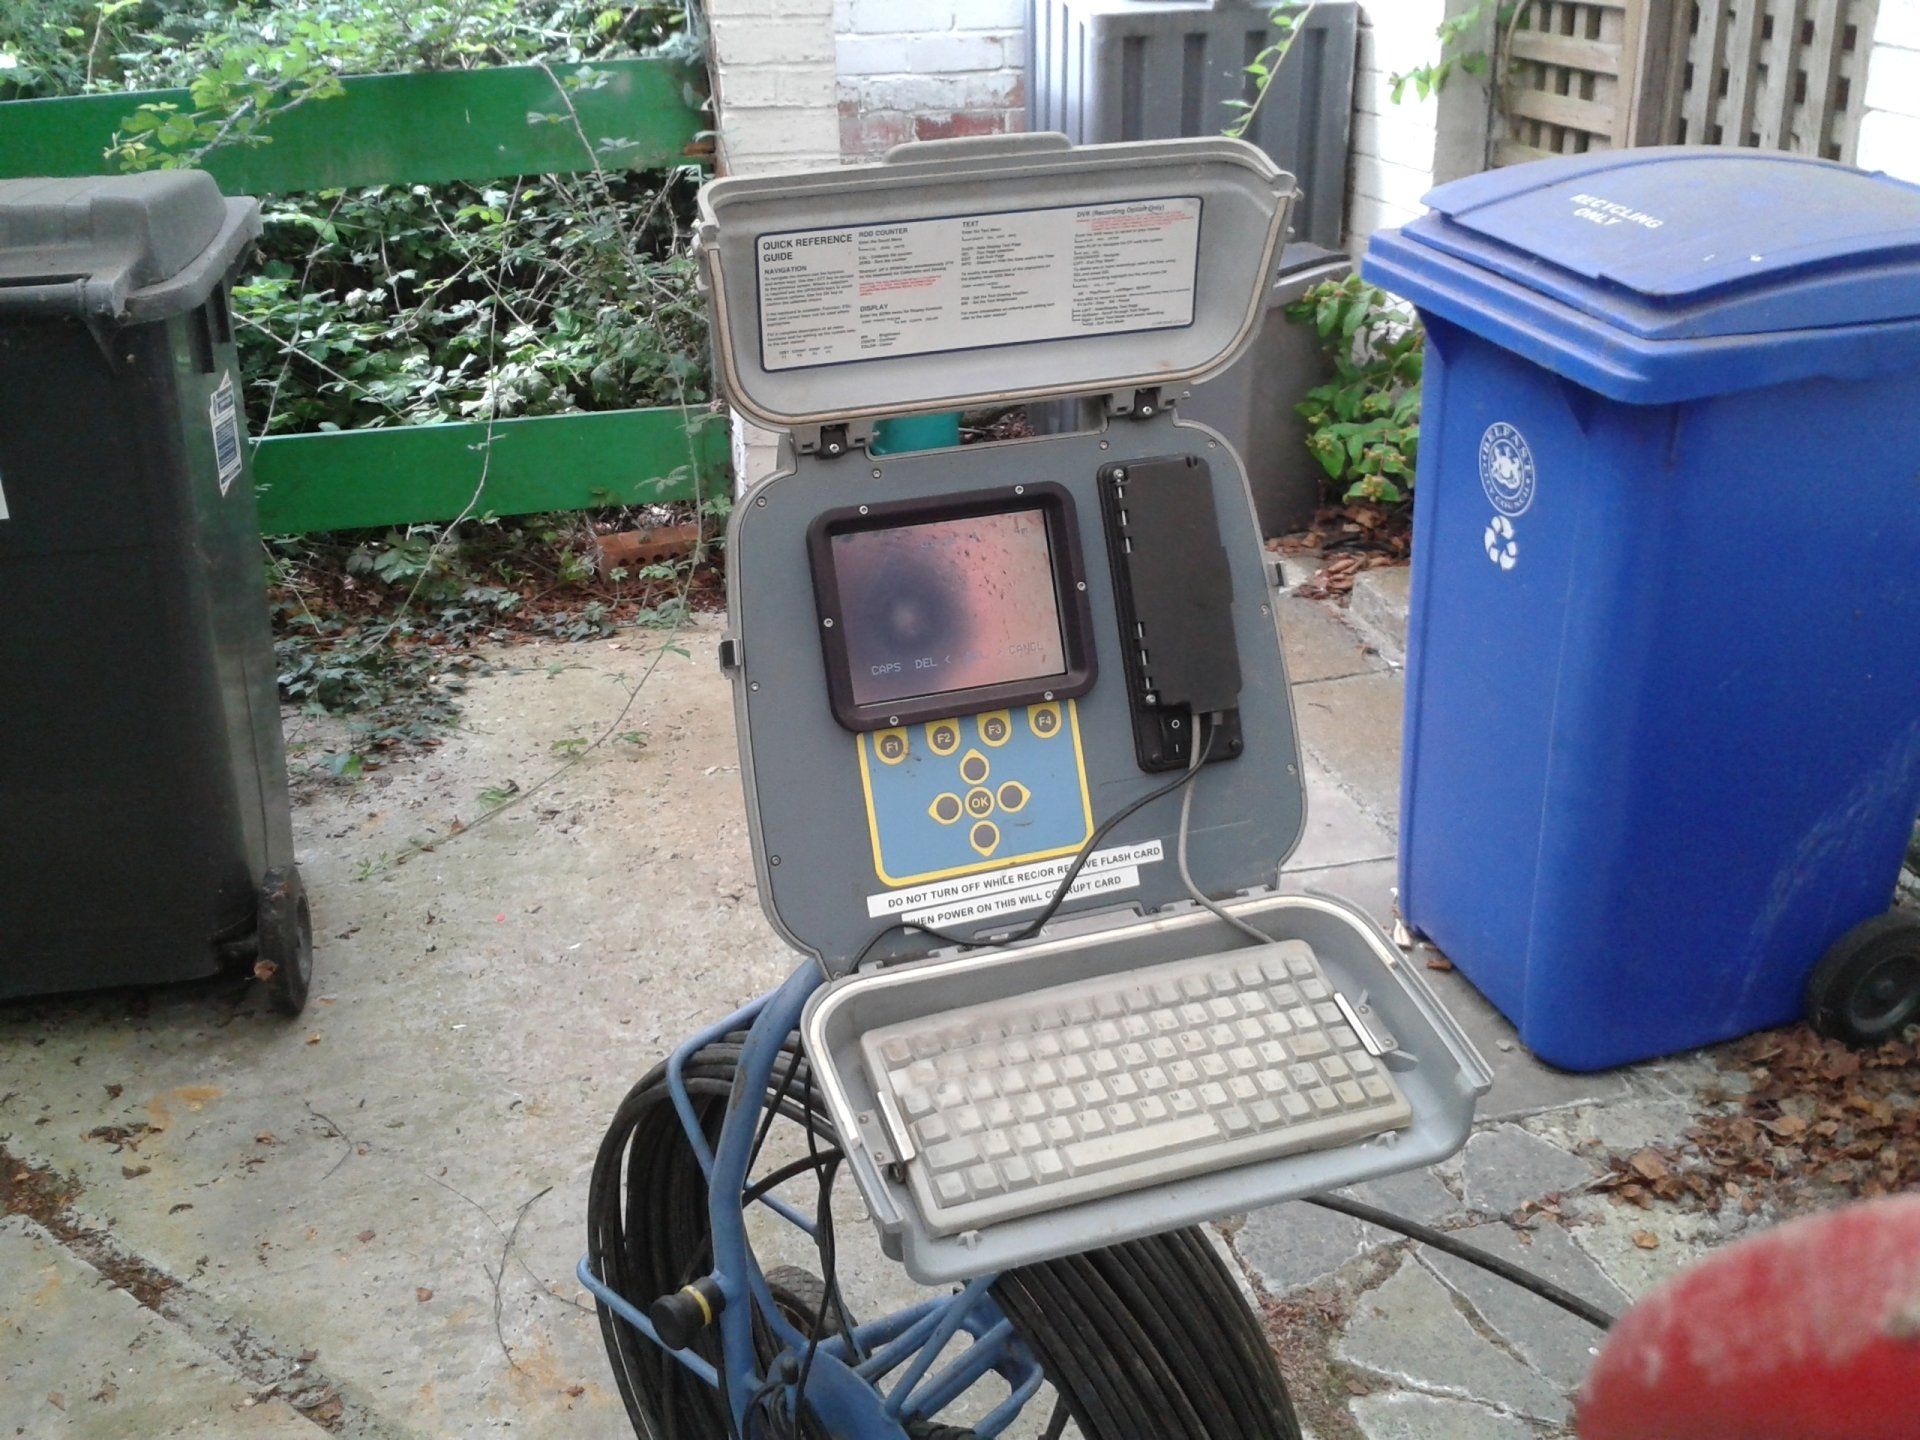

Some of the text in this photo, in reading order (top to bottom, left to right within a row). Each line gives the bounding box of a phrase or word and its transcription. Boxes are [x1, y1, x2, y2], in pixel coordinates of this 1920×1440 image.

[1077, 210, 1090, 218] DVR
[1092, 208, 1125, 217] (Recording
[1569, 194, 1664, 229] RECYCLING
[1573, 207, 1622, 226] ONLY
[875, 227, 908, 236] COUNTER
[962, 220, 979, 228] TEXT
[763, 239, 793, 251] QUICK
[795, 234, 853, 247] REFERENCE
[763, 252, 793, 262] GUIDE
[764, 265, 807, 275] NAVIGATION
[860, 303, 888, 313] DISPLAY
[871, 662, 902, 677] CAPS
[915, 656, 937, 670] DEL
[886, 715, 1052, 753] F1 F2 F3 F4
[971, 796, 988, 809] OK
[888, 847, 1160, 908] DO NOT TURN OFF WHILE REC/OR REVE FLASH CARD
[938, 906, 974, 922] POWER
[976, 903, 992, 913] ON
[995, 897, 1017, 910] THIS
[1019, 892, 1043, 904] WILL
[1045, 882, 1092, 898] CORUPT
[1094, 876, 1121, 888] CARD
